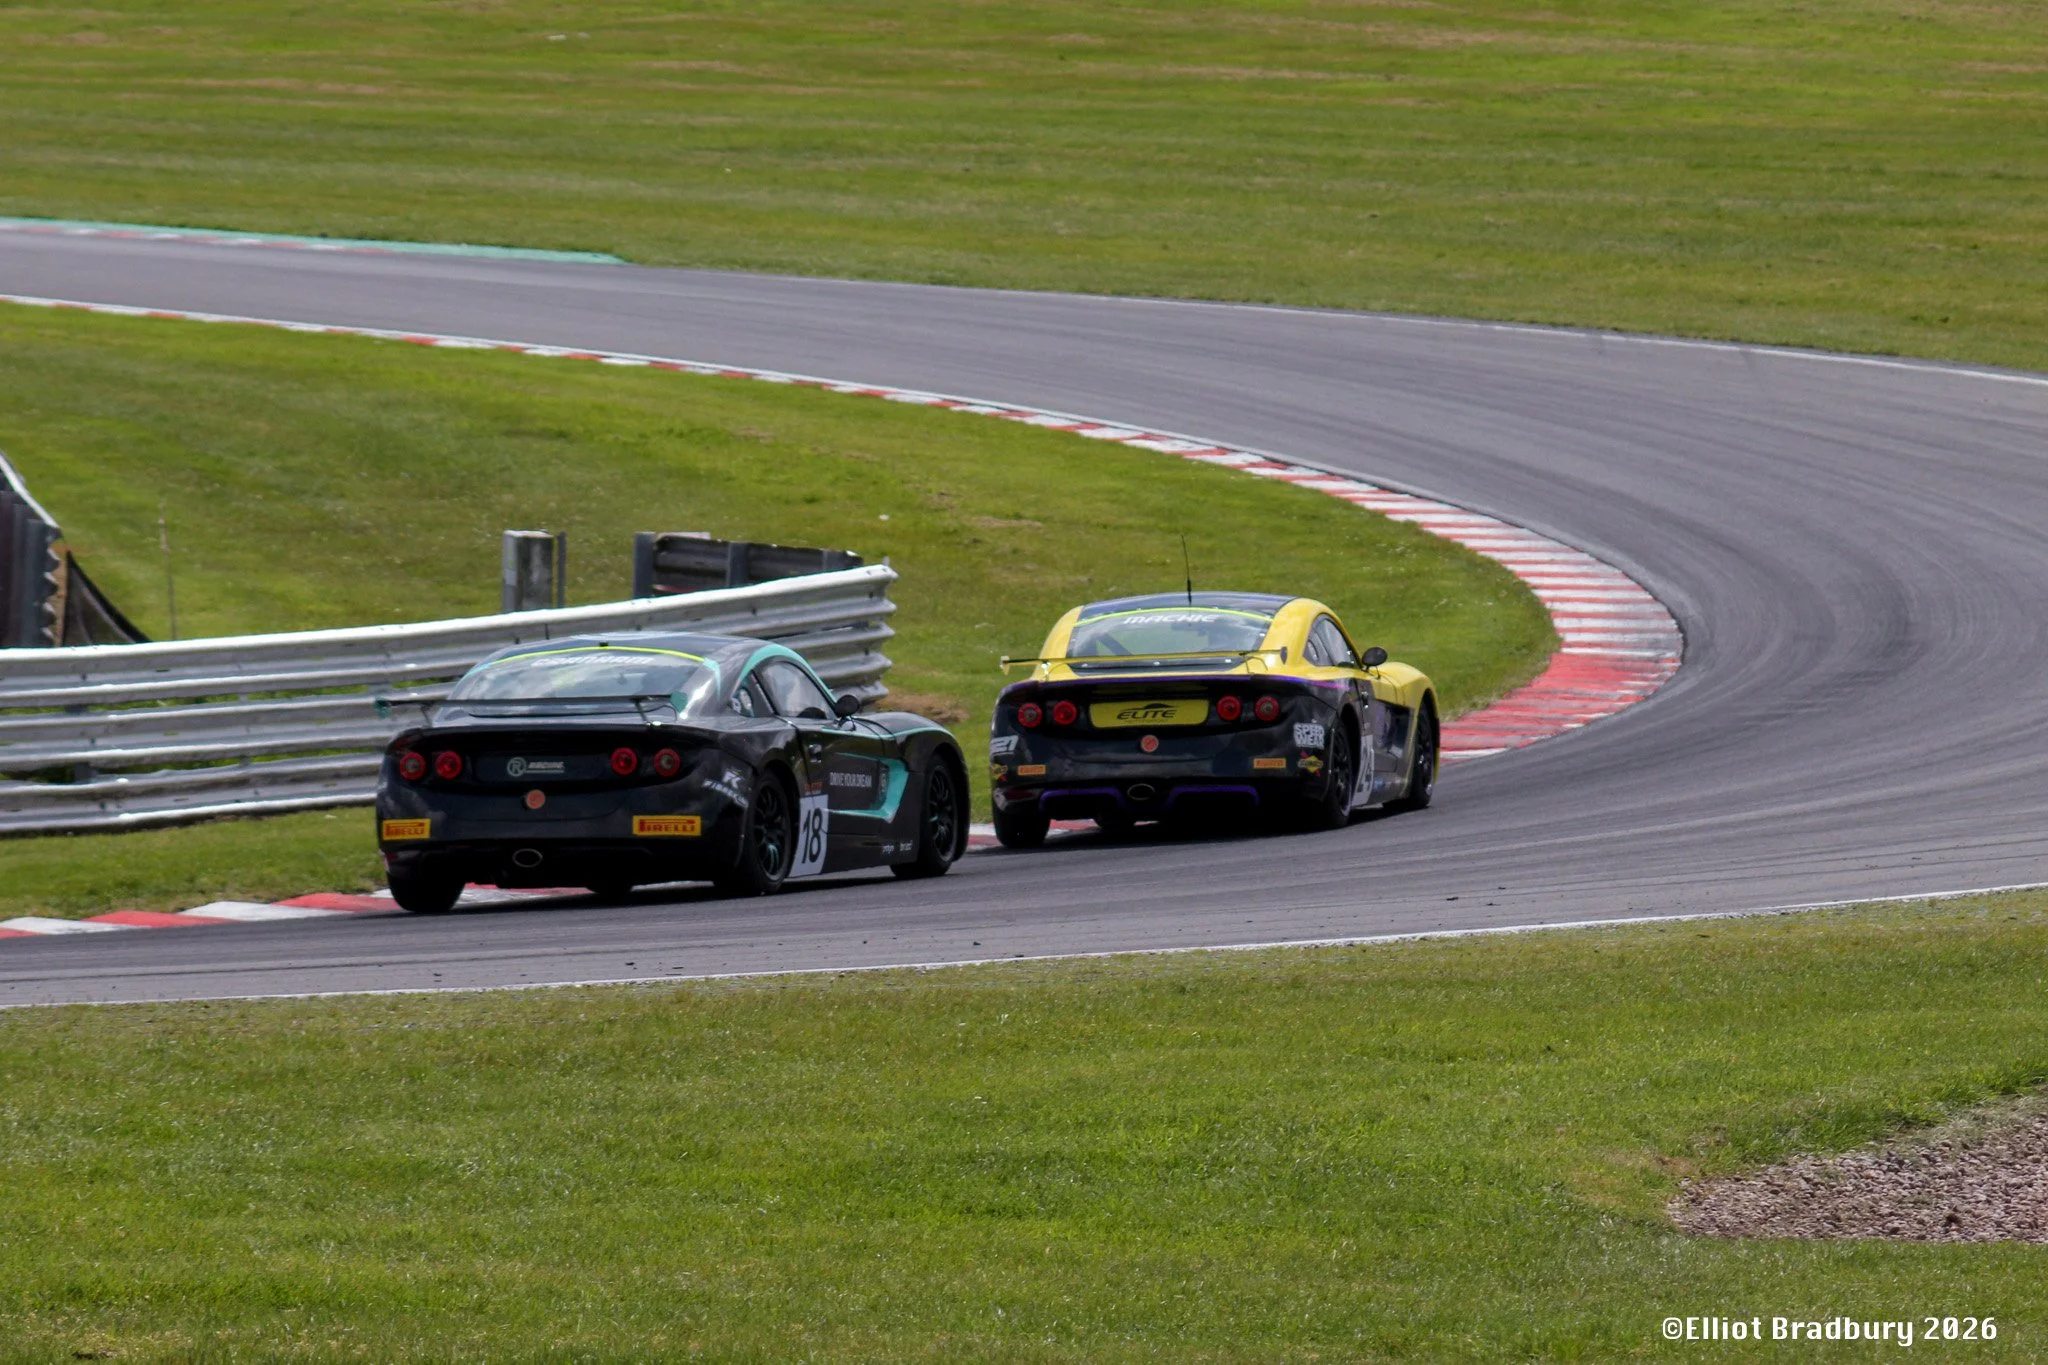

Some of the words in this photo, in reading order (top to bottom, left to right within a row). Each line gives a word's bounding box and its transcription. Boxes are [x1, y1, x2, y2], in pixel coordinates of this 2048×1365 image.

[1116, 709, 1178, 720] ELITE
[1293, 722, 1325, 735] SPEED
[1295, 733, 1325, 749] WEAR
[829, 772, 844, 786] DRIVE
[844, 773, 857, 787] YOUR
[638, 819, 697, 832] PIRELLI
[802, 808, 823, 864] 18
